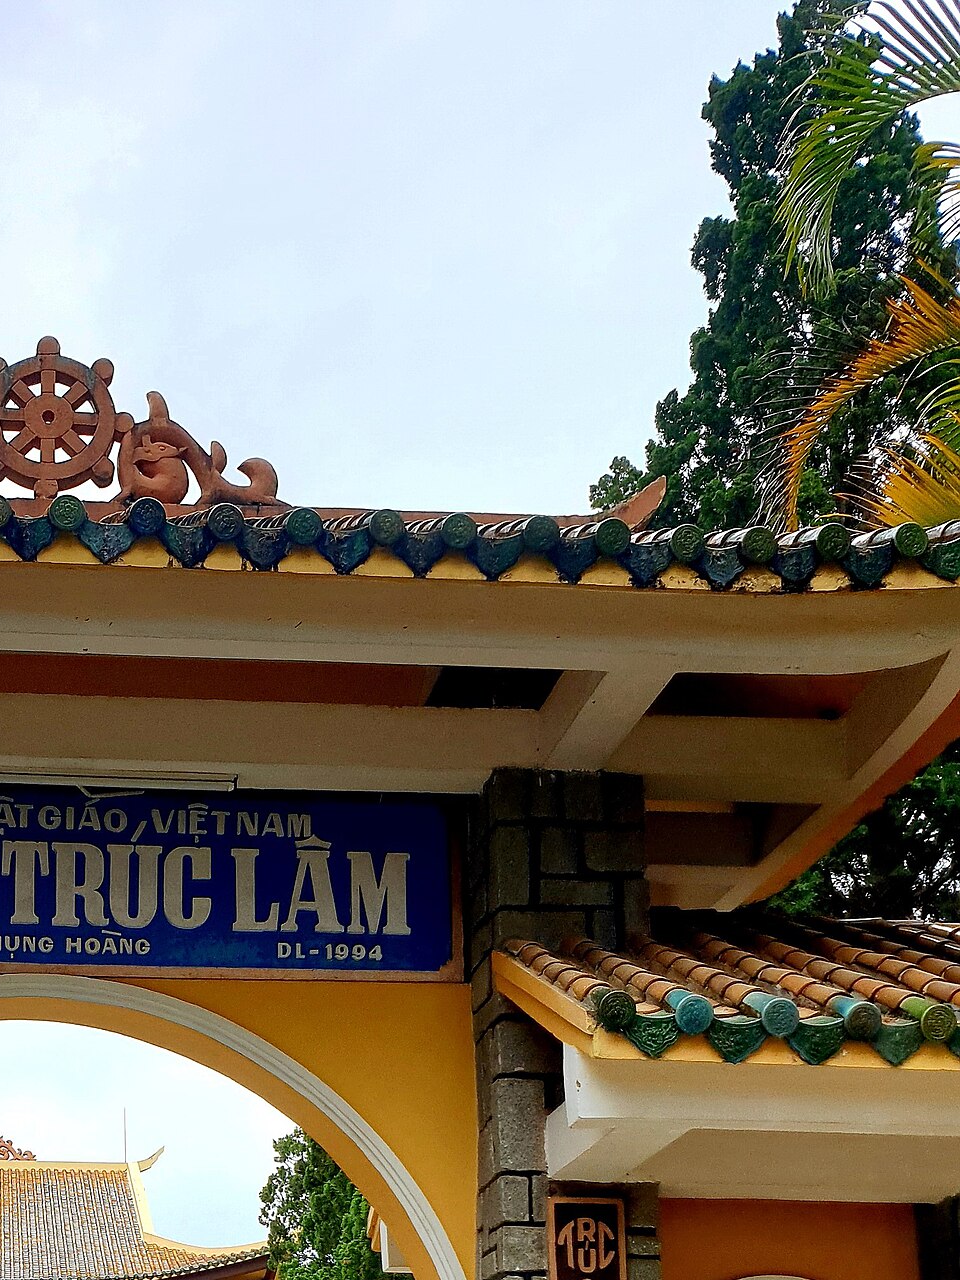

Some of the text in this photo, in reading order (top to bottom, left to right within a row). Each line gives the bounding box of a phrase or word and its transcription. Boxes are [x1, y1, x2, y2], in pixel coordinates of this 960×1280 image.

[37, 797, 129, 833] GIÁO
[151, 803, 231, 843] VIỆT
[237, 812, 313, 839] NAM
[1, 821, 213, 930] TRÚC
[230, 834, 412, 936] LÂM
[65, 929, 152, 956] HOÀNG
[277, 942, 384, 961] DL-1994
[557, 1217, 616, 1274] TRÚC
